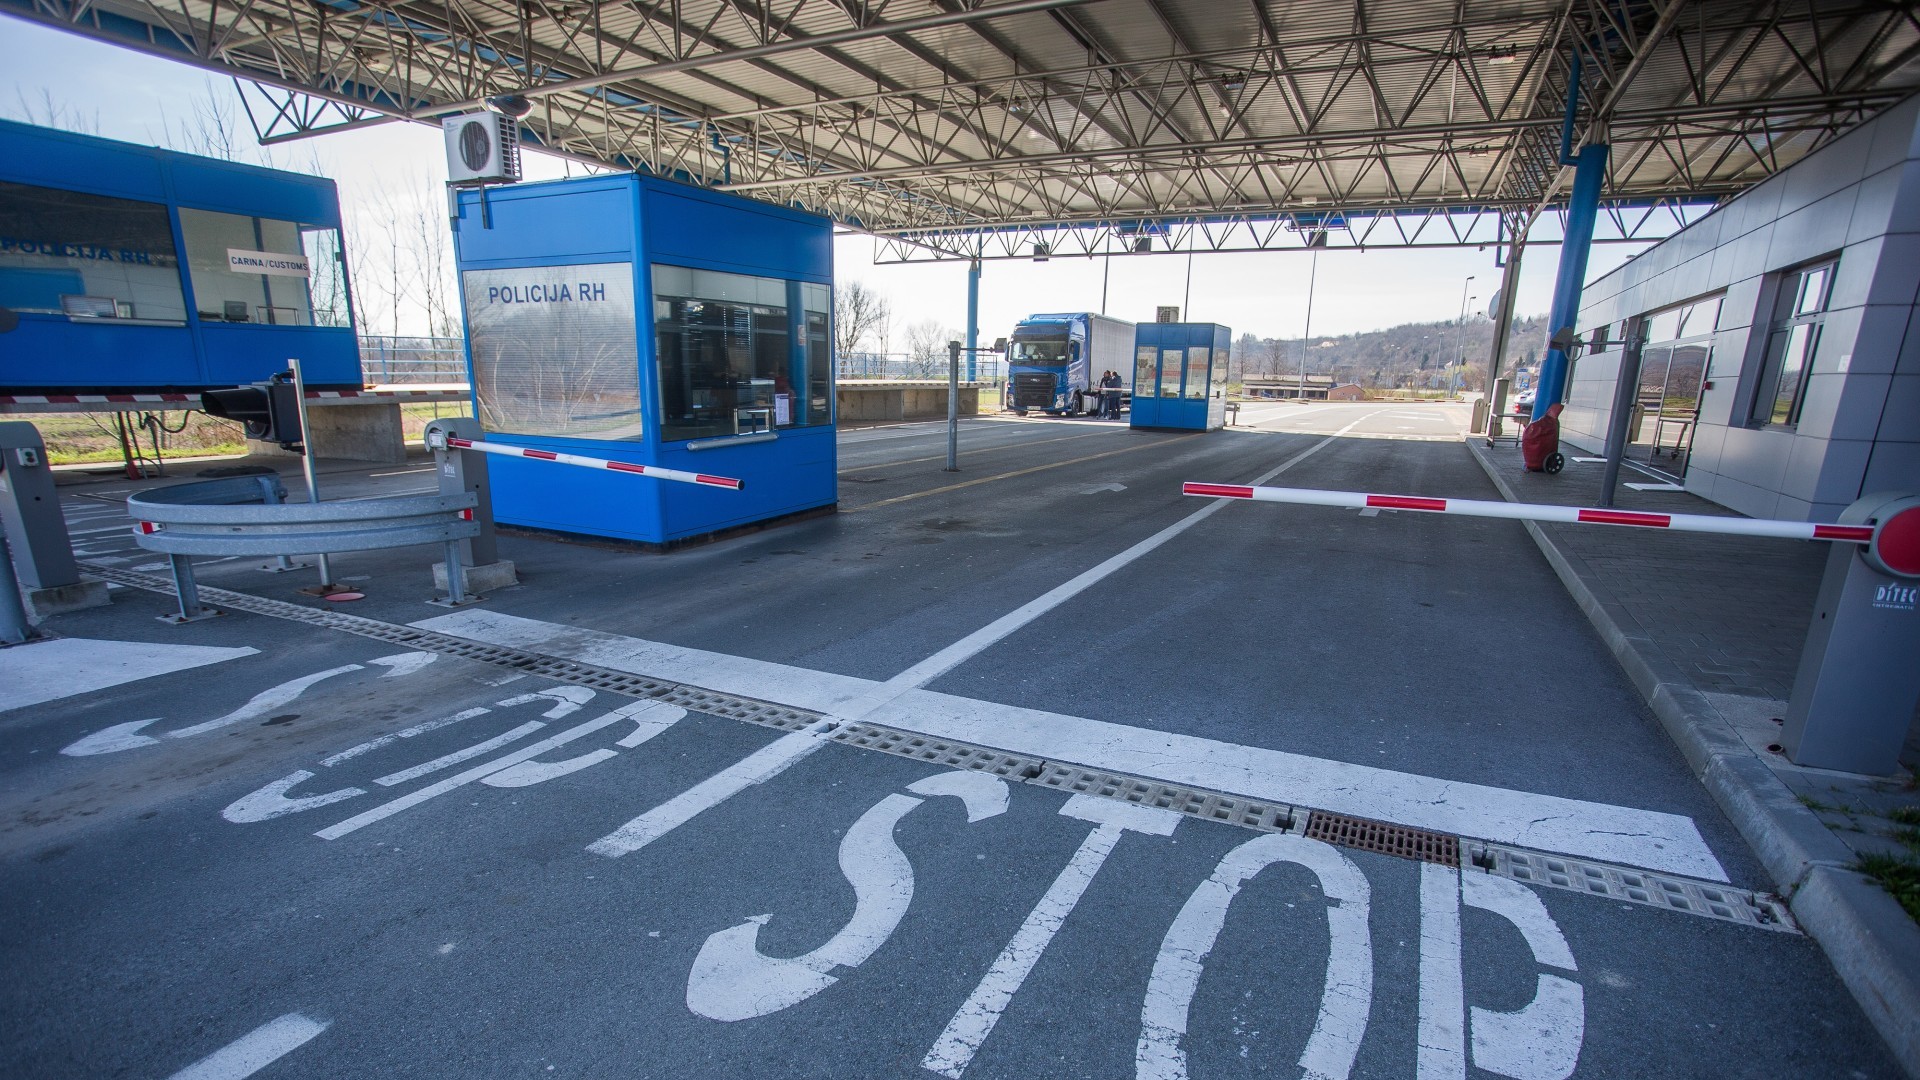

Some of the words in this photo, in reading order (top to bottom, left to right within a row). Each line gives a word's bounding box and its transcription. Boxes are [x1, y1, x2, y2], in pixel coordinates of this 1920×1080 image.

[0, 236, 114, 261] POLICIJA
[120, 248, 150, 265] RH
[488, 284, 572, 304] POLICIJA
[579, 282, 606, 301] RH
[686, 769, 1586, 1080] STOP
